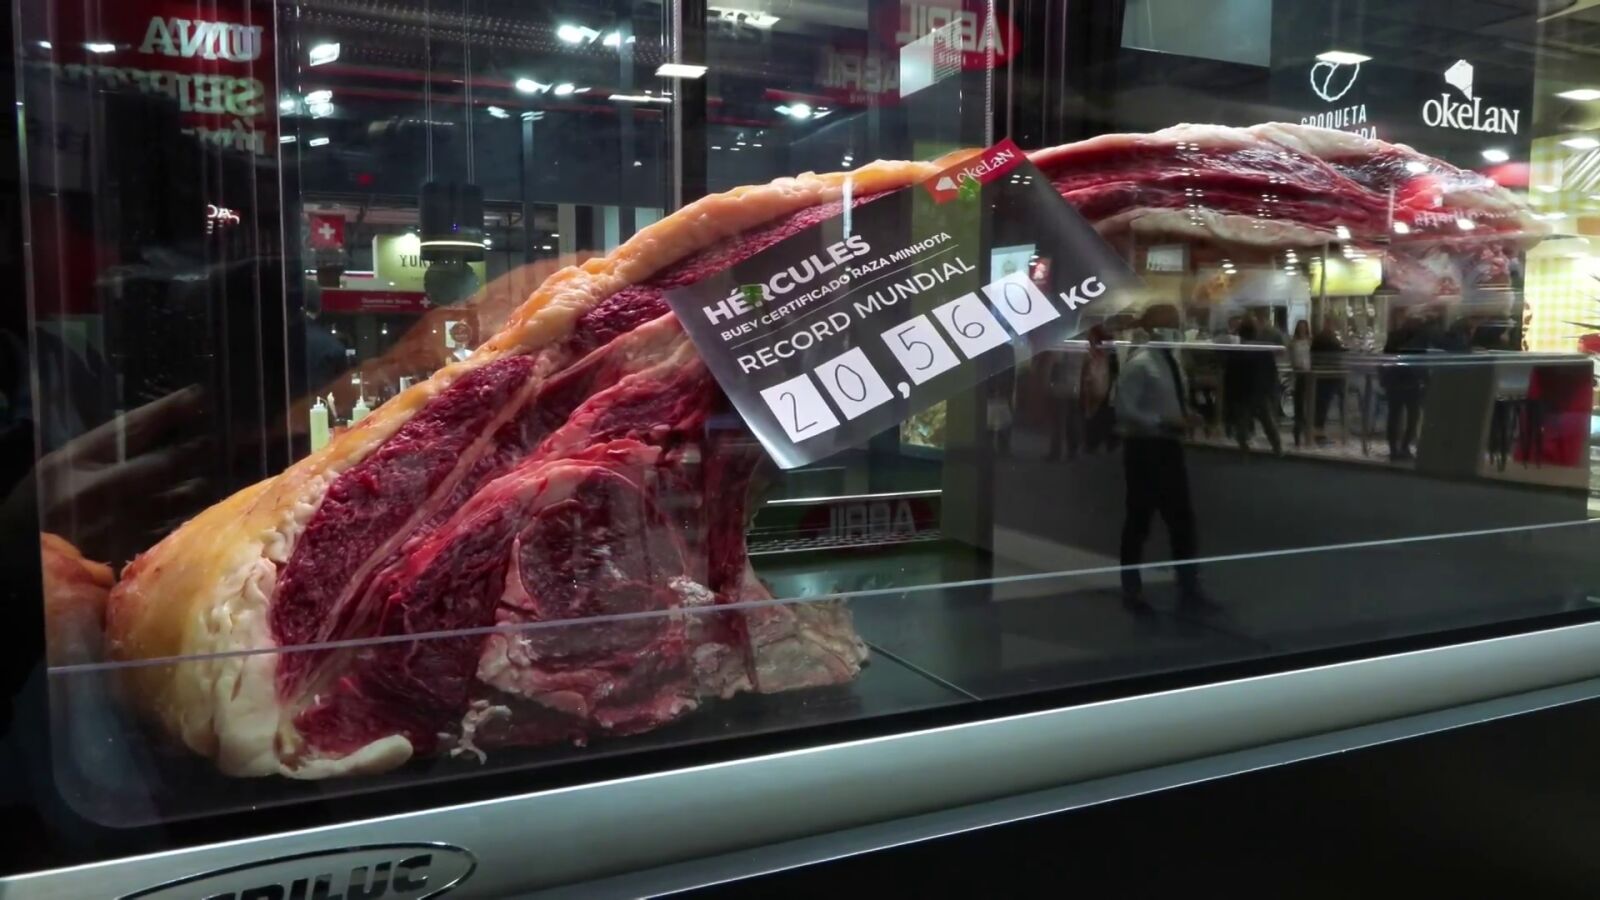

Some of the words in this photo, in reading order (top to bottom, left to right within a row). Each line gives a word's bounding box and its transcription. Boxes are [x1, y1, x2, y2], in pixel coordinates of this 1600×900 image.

[702, 234, 871, 325] HÉRCULES
[720, 319, 759, 342] BUEY
[761, 272, 850, 325] CERTIFICADO
[851, 256, 891, 279] RAZA
[889, 231, 952, 264] MINHOTA
[736, 311, 852, 375] RECORD
[853, 256, 976, 319] MUNDIAL
[1058, 275, 1107, 310] KG
